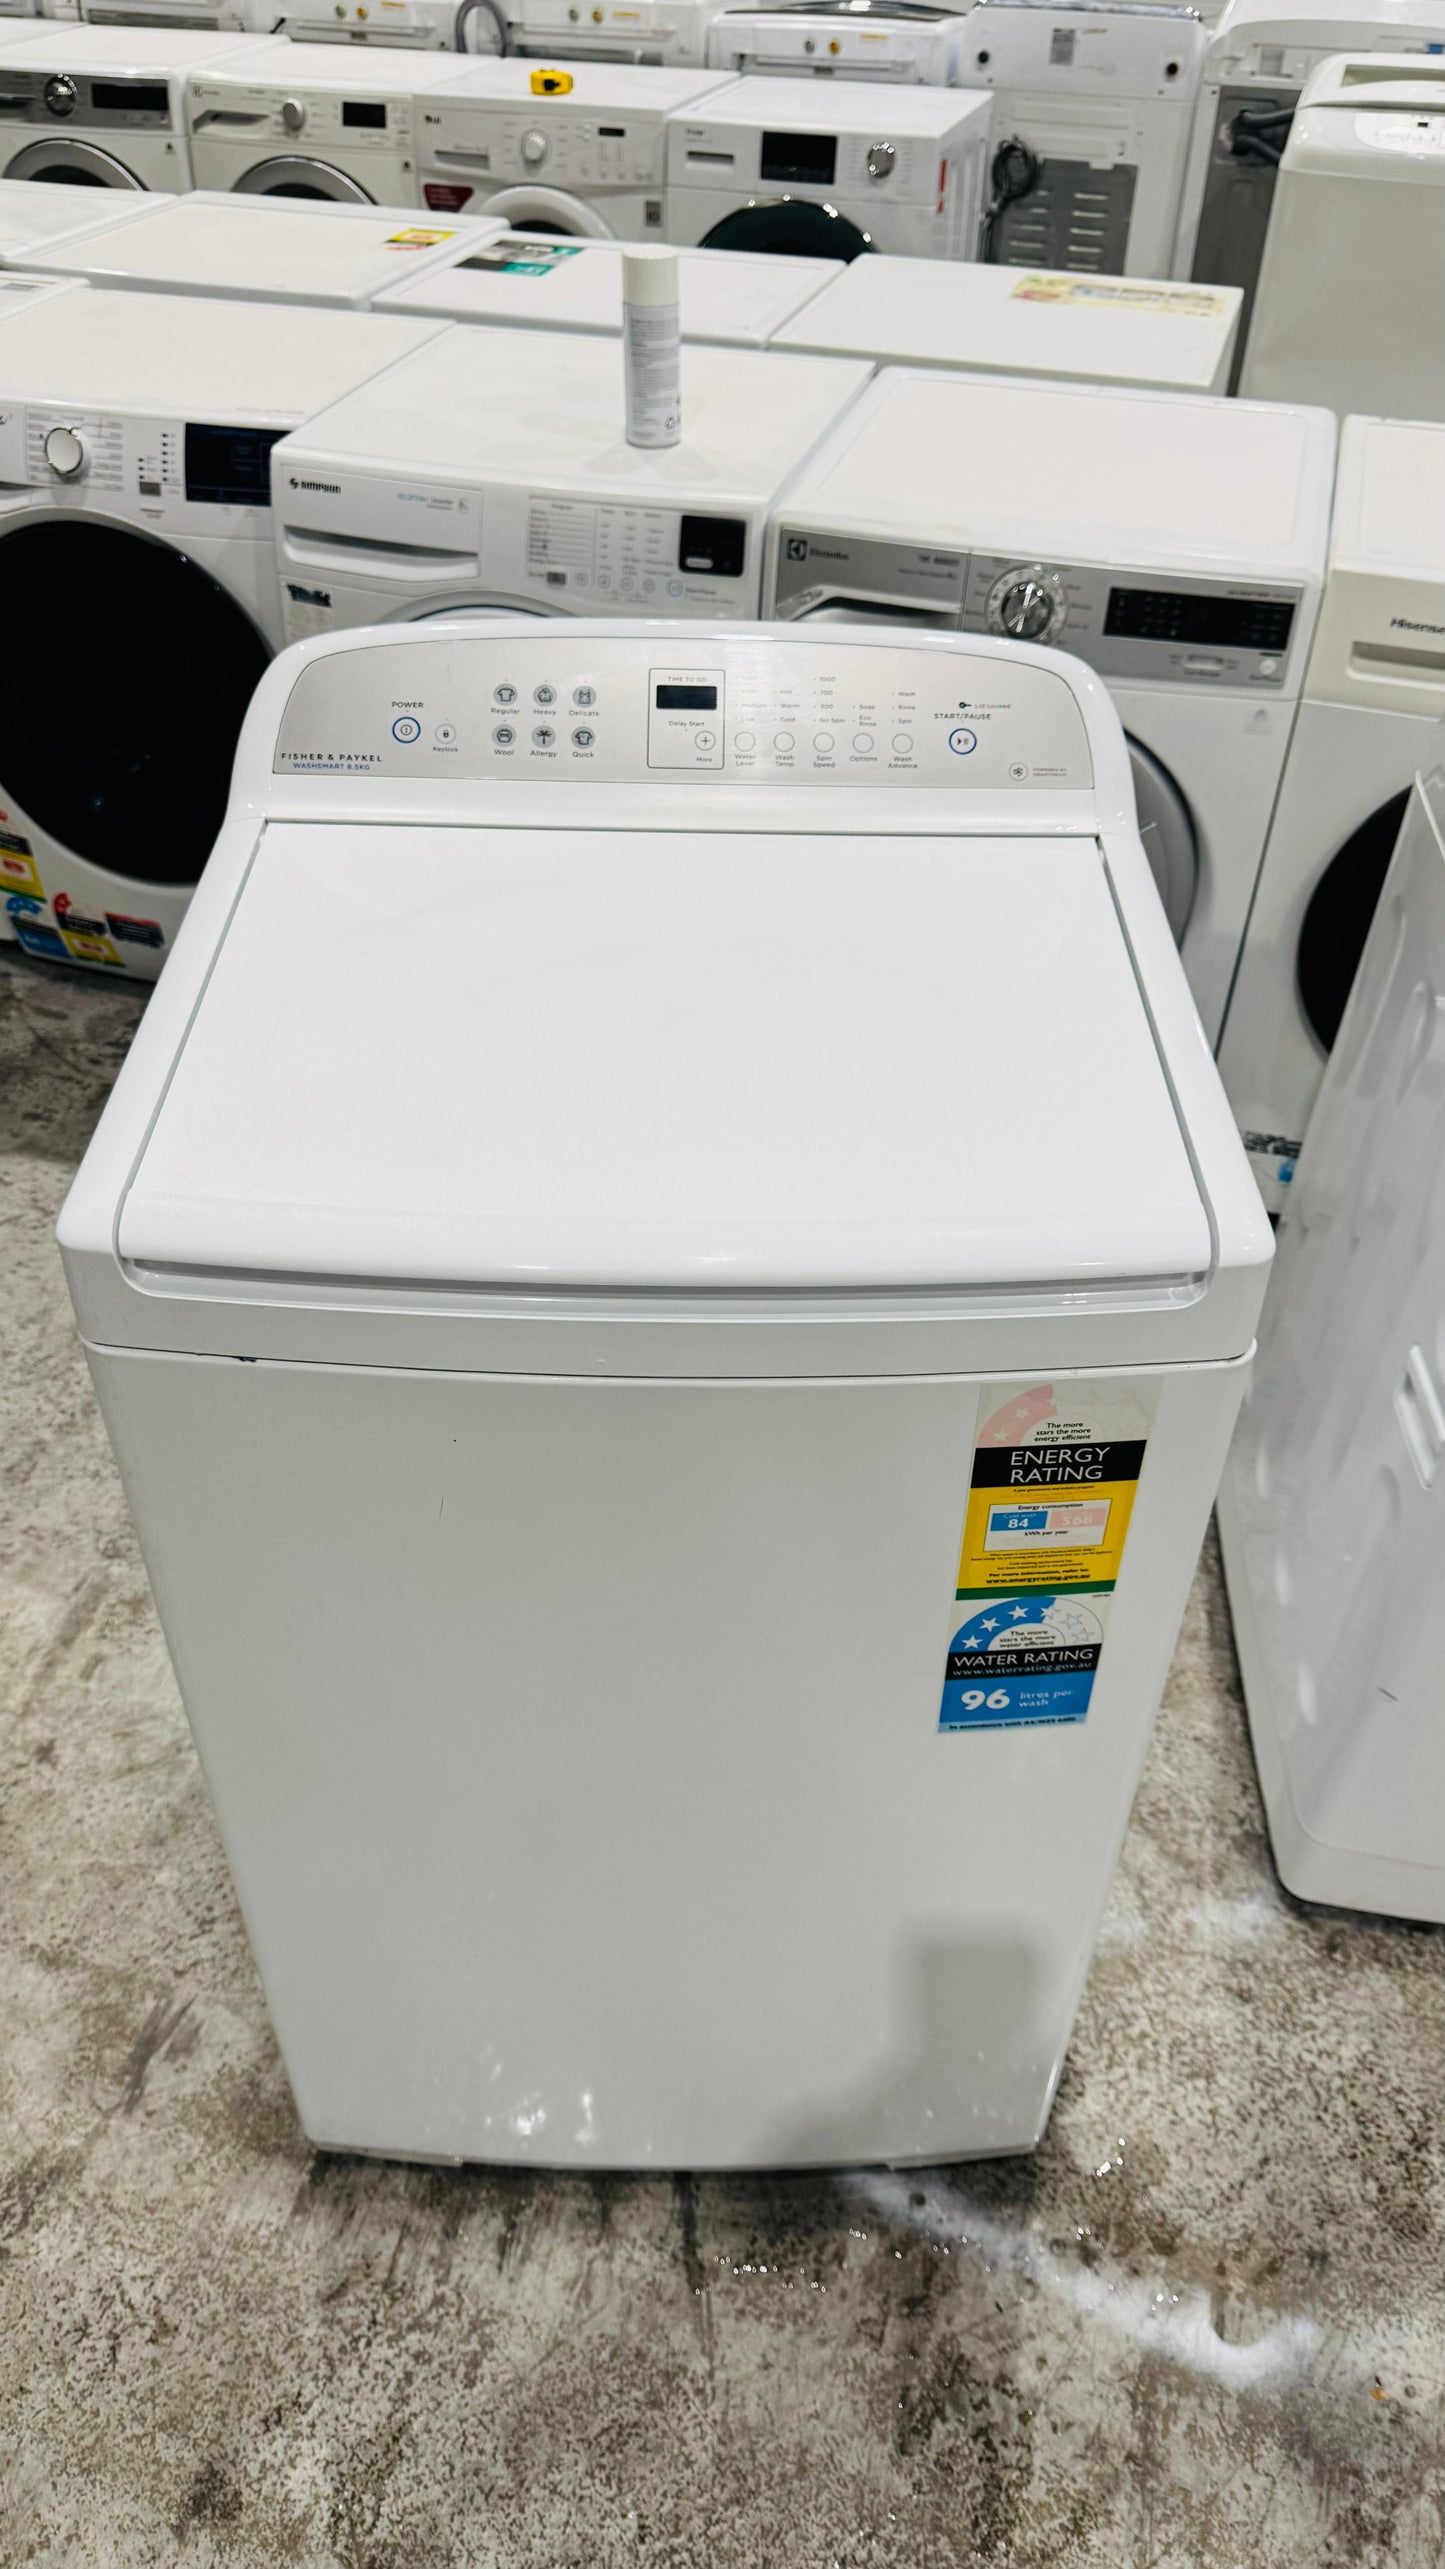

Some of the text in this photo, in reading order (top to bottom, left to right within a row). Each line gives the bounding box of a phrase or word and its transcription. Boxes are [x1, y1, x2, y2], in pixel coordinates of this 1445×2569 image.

[301, 480, 341, 494] SIMPSON
[490, 708, 520, 716] Regular
[533, 708, 556, 718] Heavy
[569, 710, 600, 718] Delicate
[668, 720, 706, 728] Delay Start
[432, 746, 458, 754] Keylock
[530, 750, 558, 759] Allergy
[572, 750, 594, 759] Quick
[280, 752, 383, 762] FISHER & PAYKEL
[293, 762, 345, 770] WASHSMART
[1010, 1447, 1111, 1466] ENERGY
[1010, 1466, 1104, 1484] RATING
[1042, 1502, 1084, 1510] consumption
[1008, 1518, 1030, 1529] 84
[986, 1574, 1091, 1584] www.energyrating.gov.au
[954, 1648, 1094, 1667] WATER RATING
[952, 1661, 1092, 1677] www.waterrating.gov.au
[960, 1688, 1010, 1711] 96
[1020, 1690, 1074, 1700] litres per
[1018, 1700, 1049, 1708] wash
